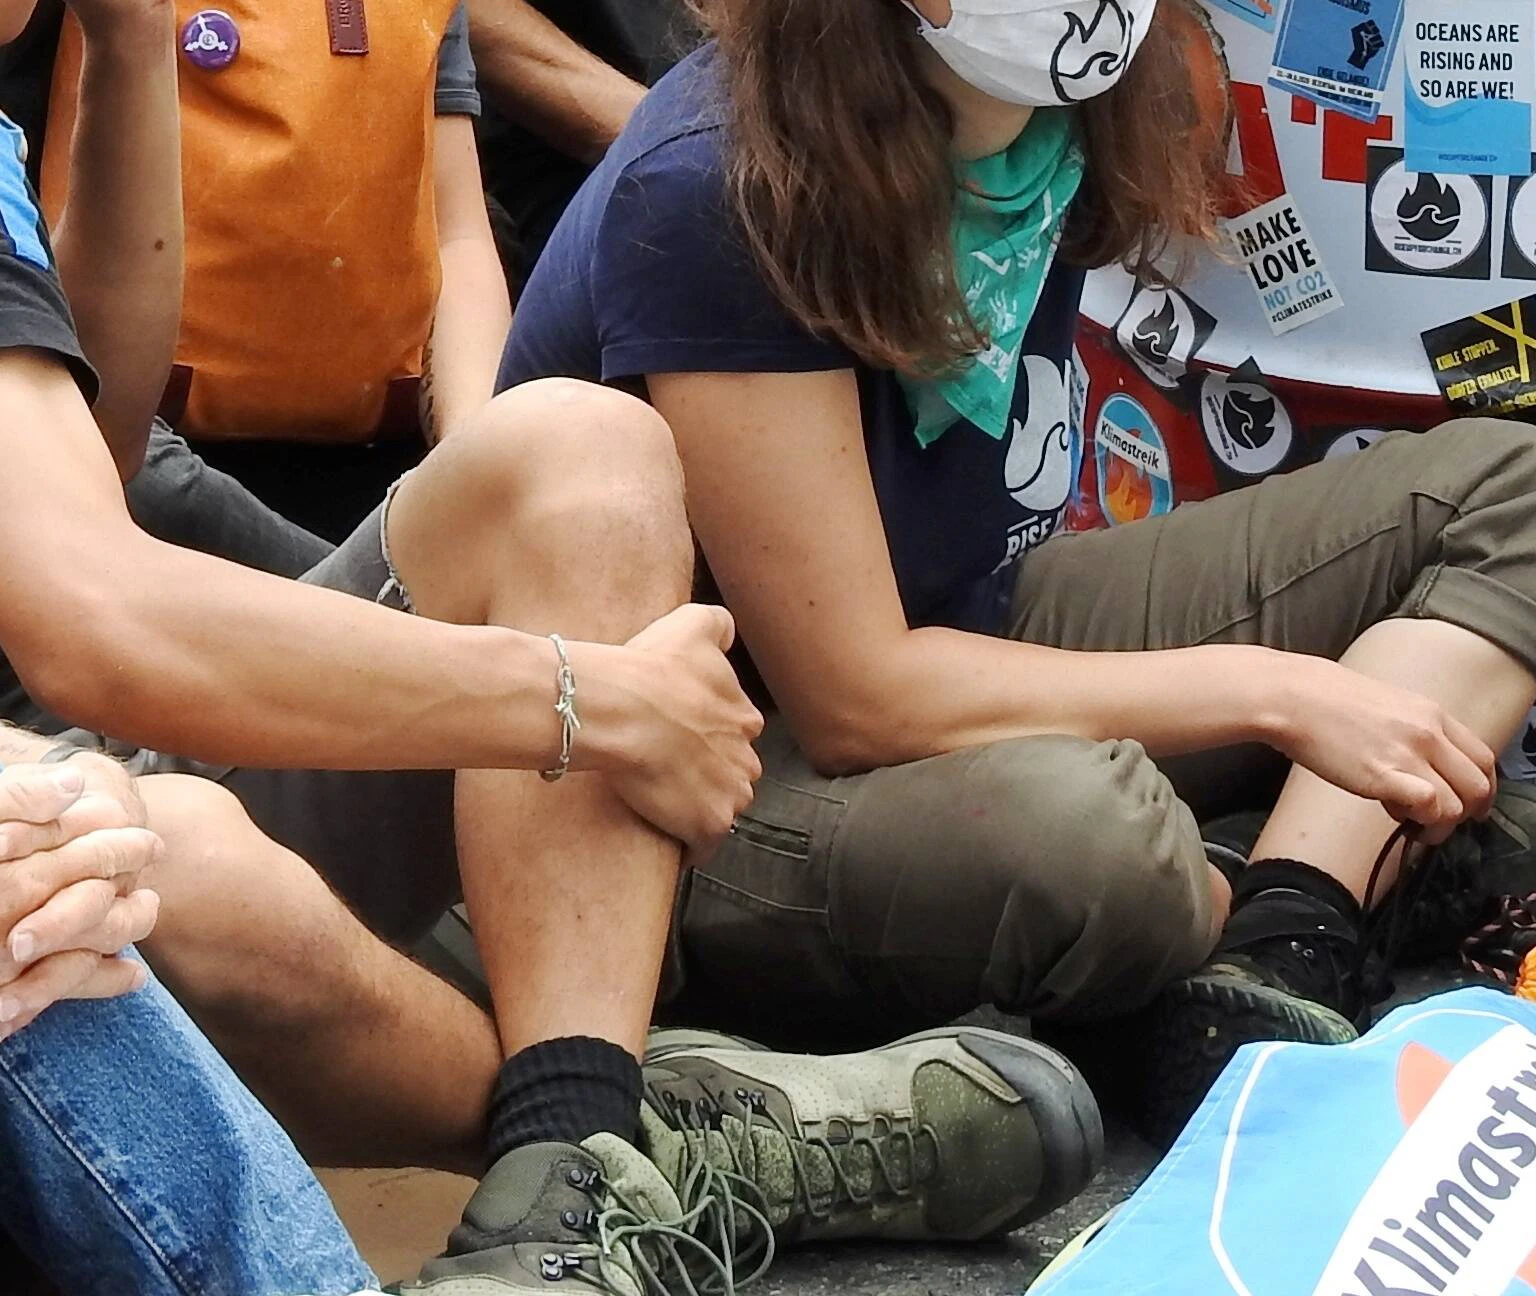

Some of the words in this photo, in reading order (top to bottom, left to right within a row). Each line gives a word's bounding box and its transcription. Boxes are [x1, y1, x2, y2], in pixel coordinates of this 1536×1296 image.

[1415, 22, 1482, 42] OCEANS
[1486, 23, 1520, 43] ARE
[1420, 51, 1475, 71] RISING
[1478, 52, 1513, 72] AND
[1420, 79, 1441, 98] SO
[1445, 80, 1478, 100] ARE
[1482, 81, 1514, 101] WE!
[1235, 206, 1302, 258] MAKE
[1248, 237, 1317, 291] LOVE
[1263, 286, 1293, 313] NOT
[1295, 270, 1328, 296] CO2
[1271, 288, 1334, 324] #CLIMATESTRIKE
[1100, 420, 1161, 471] Klimastreik
